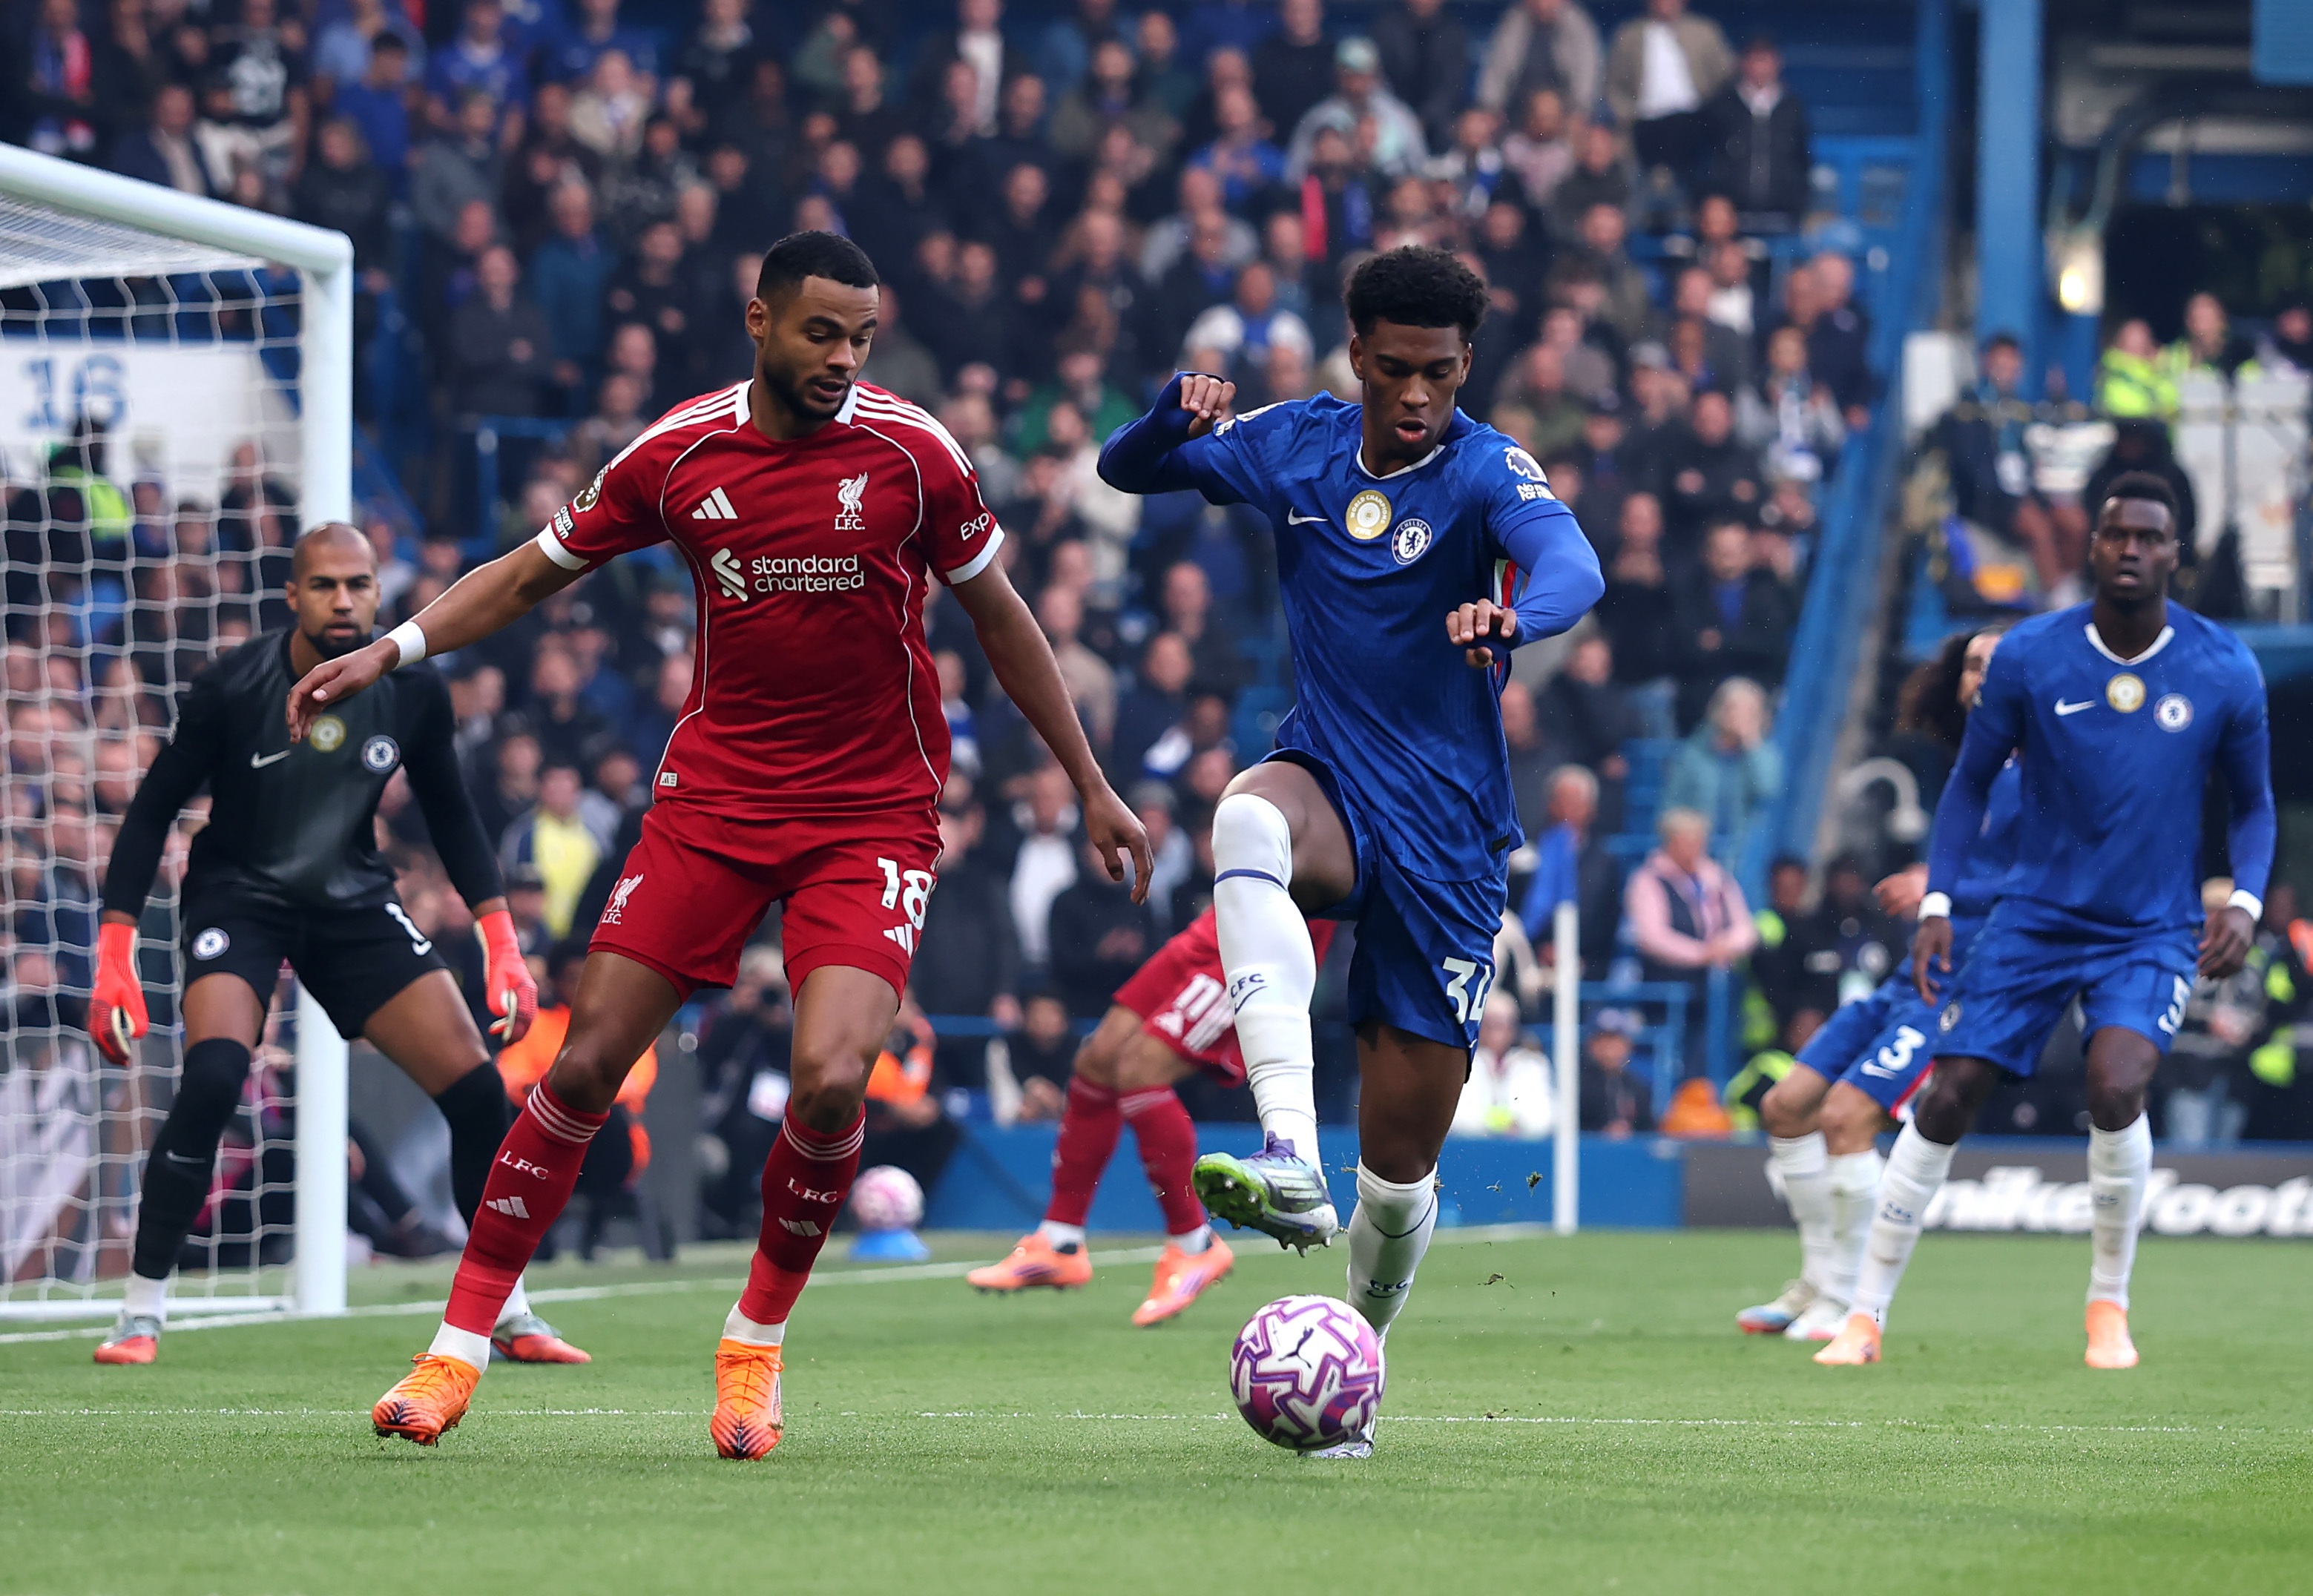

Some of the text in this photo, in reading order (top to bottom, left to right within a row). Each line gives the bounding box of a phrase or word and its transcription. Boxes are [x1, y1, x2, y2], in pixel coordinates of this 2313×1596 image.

[27, 355, 126, 432] 16
[1350, 496, 1366, 518] WORLD
[960, 512, 990, 541] Exp
[1400, 520, 1427, 531] CHELSEA
[751, 554, 858, 575] standard
[754, 570, 865, 593] chartered
[878, 857, 932, 930] 18
[1230, 973, 1266, 998] CFC
[1878, 1024, 1927, 1072] 3
[500, 1150, 549, 1181] LFC
[786, 1176, 838, 1204] LFC
